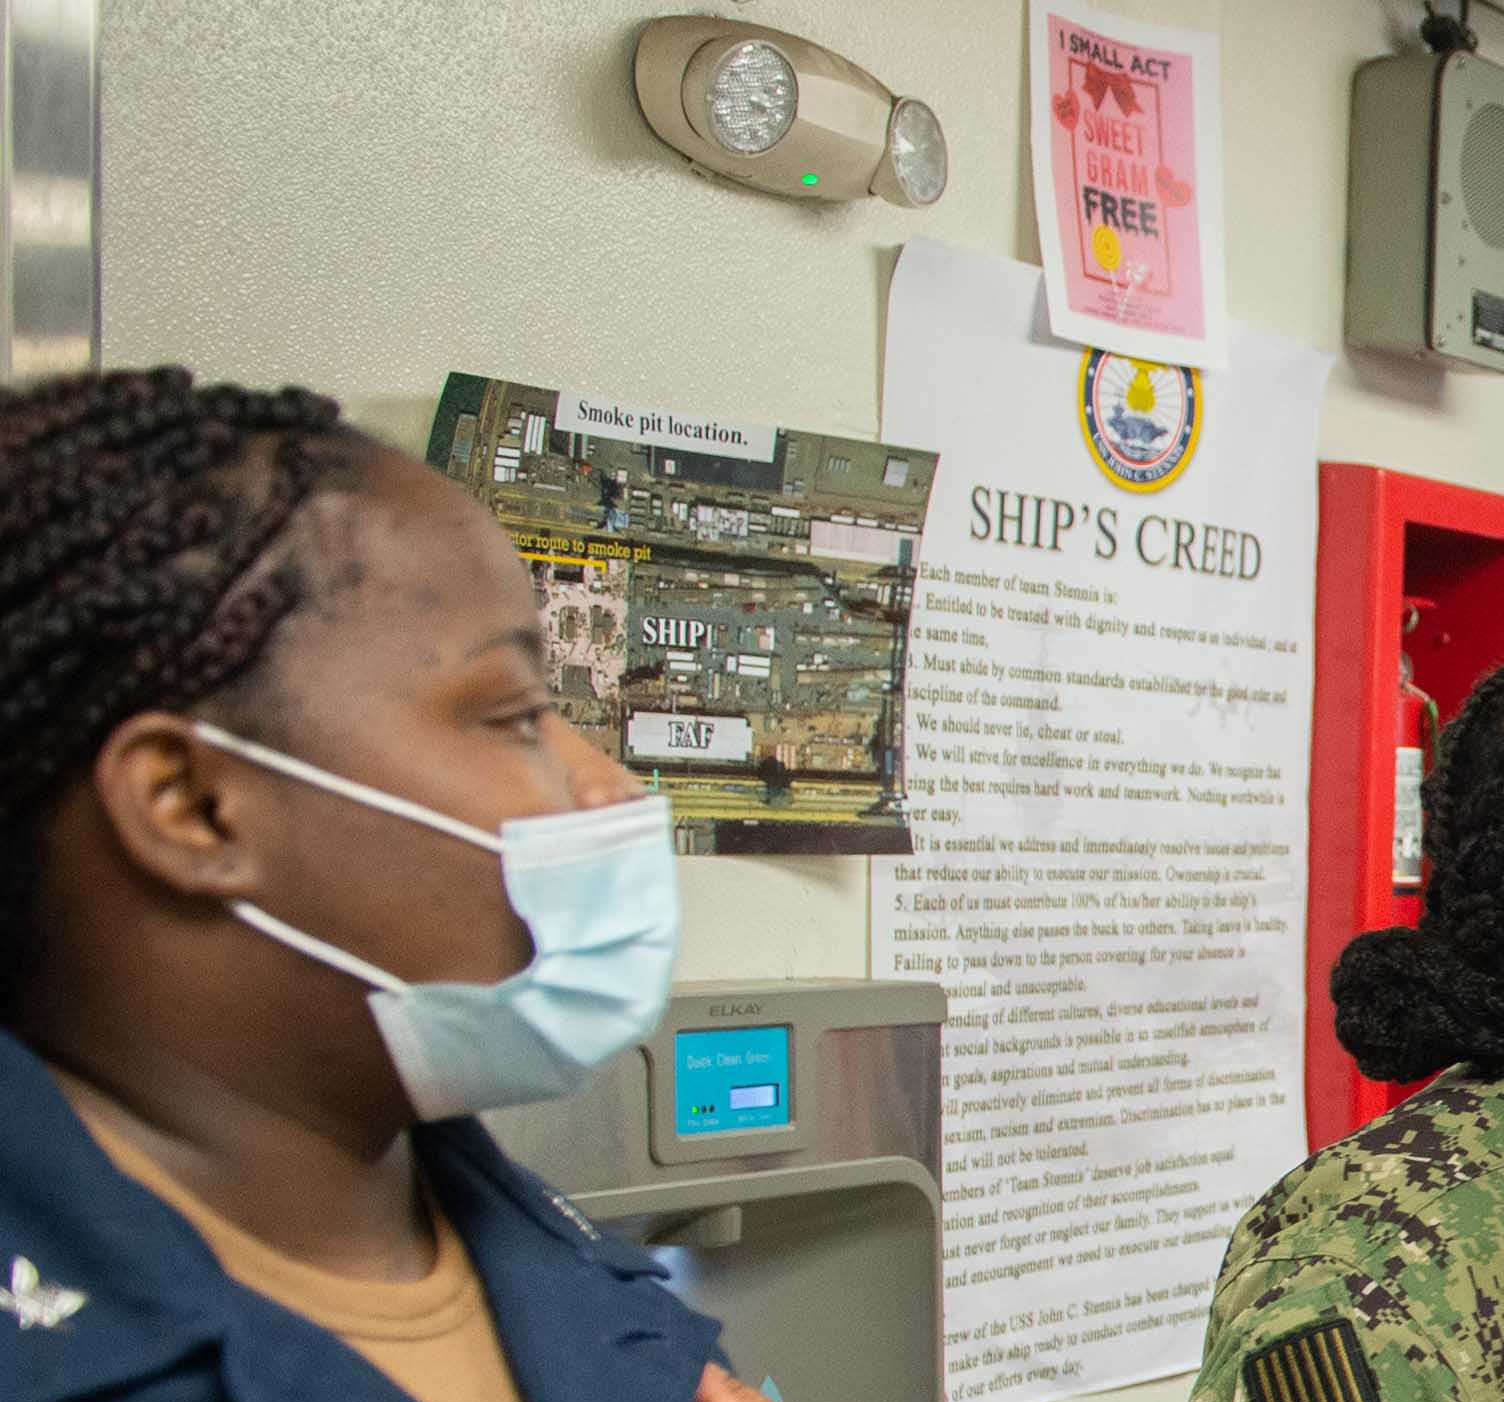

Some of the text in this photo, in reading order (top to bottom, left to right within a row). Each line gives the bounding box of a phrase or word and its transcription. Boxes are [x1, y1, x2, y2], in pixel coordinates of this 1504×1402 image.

[1069, 32, 1123, 69] SMALL
[1130, 55, 1171, 82] ACT
[1083, 109, 1145, 157] SWEET
[1086, 149, 1149, 197] GRAM
[1082, 186, 1159, 237] FREE
[577, 400, 748, 446] Smoke pit location.
[536, 535, 569, 551] route
[573, 540, 585, 553] to
[588, 542, 631, 558] smoke
[634, 544, 651, 562] pit
[1135, 514, 1262, 581] CREED
[920, 562, 1049, 598] Each member of team
[926, 592, 1155, 638] Entitled to be treated with dignity and
[642, 616, 705, 648] SHIP
[927, 628, 957, 643] same
[923, 653, 1125, 690] Must abide by common standards
[967, 688, 997, 706] of the
[668, 720, 715, 749] FAF
[916, 712, 1089, 743] We should never lie, cheat or
[916, 744, 1167, 779] We will strive for excellence everything
[940, 774, 1120, 800] the best requires hard work and
[914, 834, 1079, 853] It is essential we address and
[894, 864, 1161, 885] that reduce our ability our mission.
[894, 893, 1118, 912] 5. Each of us must of
[894, 921, 1135, 943] mission. Anything else to
[894, 946, 1167, 974] Failing to pass down to the person covering for
[991, 980, 1011, 995] and
[709, 1002, 763, 1016] ELKAY
[992, 1006, 1055, 1024] of different
[953, 1029, 1121, 1057] social backgrounds possible
[953, 1060, 1075, 1090] goals, aspirations and
[962, 1082, 1144, 1118] proactively eliminate and prevent
[991, 1118, 1054, 1139] racism and
[945, 1148, 1033, 1173] and will not be
[988, 1181, 1002, 1196] of
[977, 1194, 1082, 1225] and recognition of
[964, 1223, 1089, 1257] never forget or neglect
[945, 1248, 1101, 1289] and encouragement we need
[974, 1309, 1064, 1339] of the USS John
[948, 1343, 1031, 1374] make this ship
[952, 1369, 1023, 1402] of our efforts
